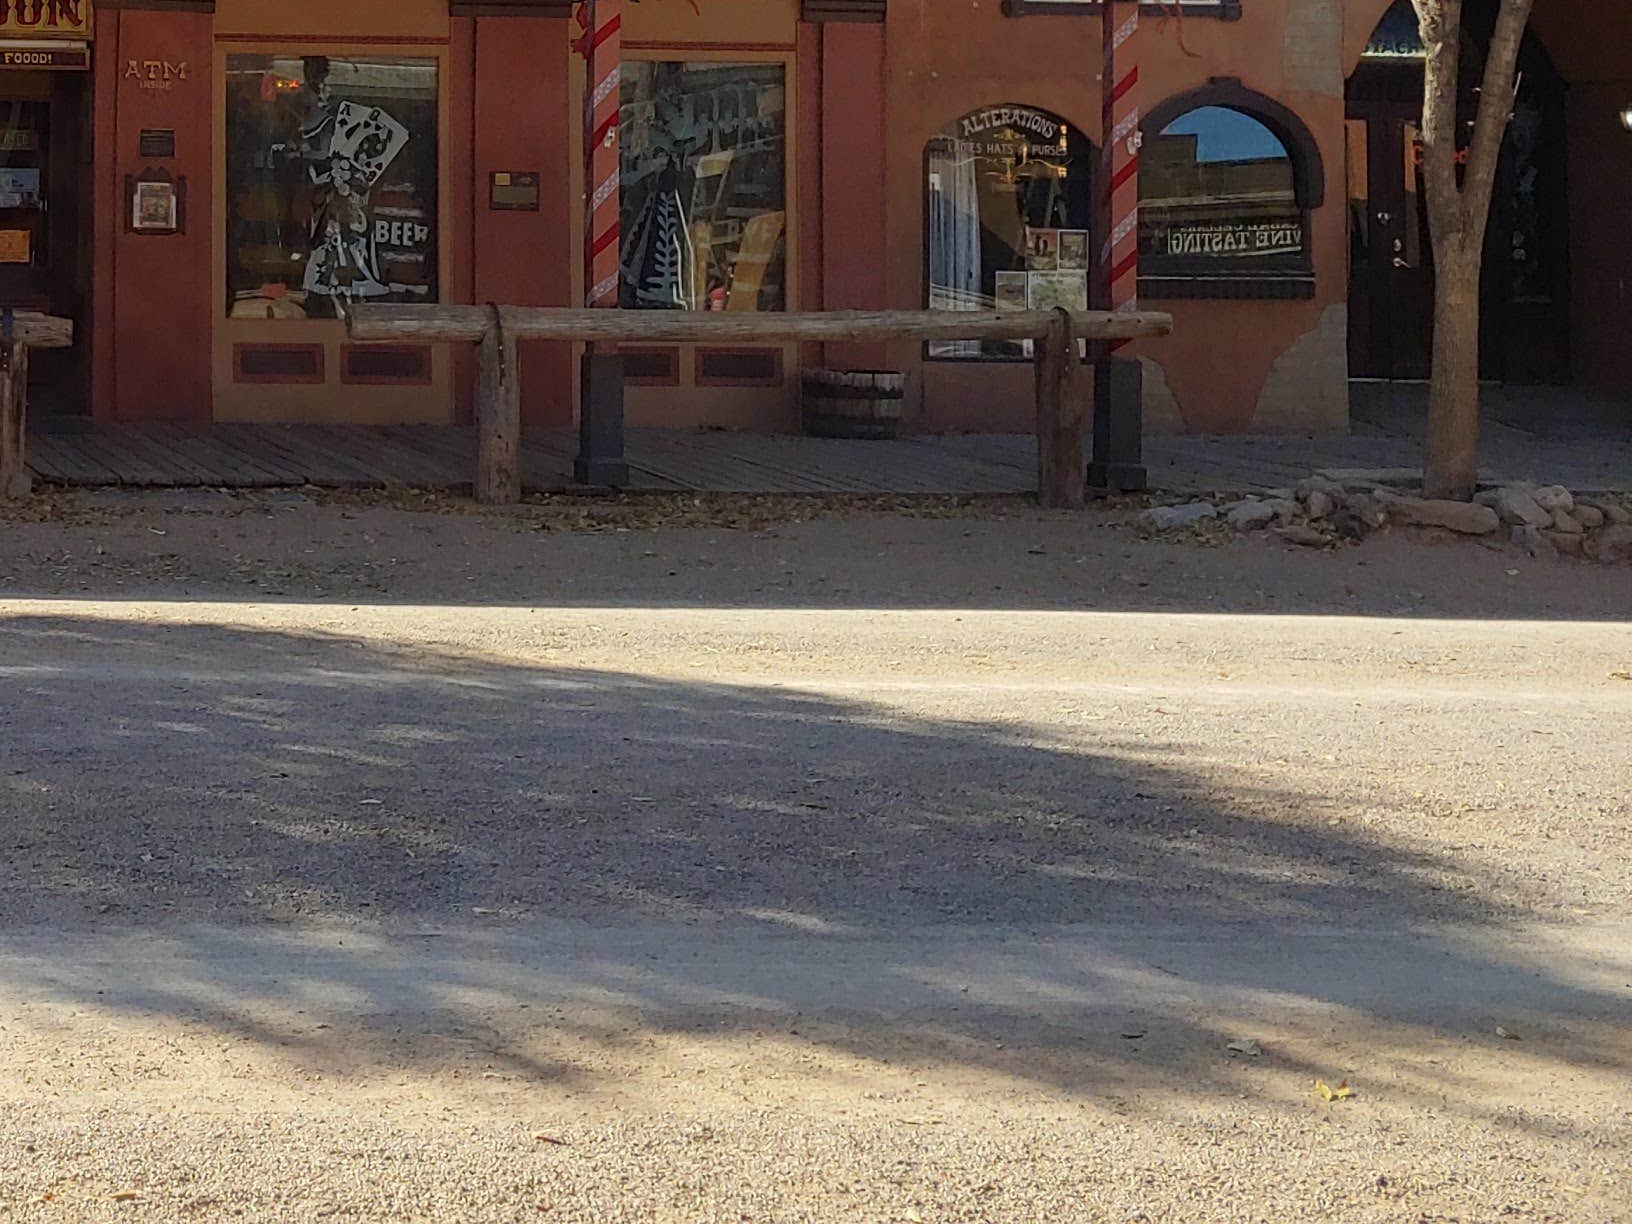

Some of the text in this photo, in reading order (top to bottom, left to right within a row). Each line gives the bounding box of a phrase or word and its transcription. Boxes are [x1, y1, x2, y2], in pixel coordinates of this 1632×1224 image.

[4, 52, 53, 64] FOOOD!
[124, 59, 187, 80] ATM
[961, 107, 1058, 139] ALTERATIONS
[986, 142, 1014, 155] HATS
[374, 219, 430, 247] BEER
